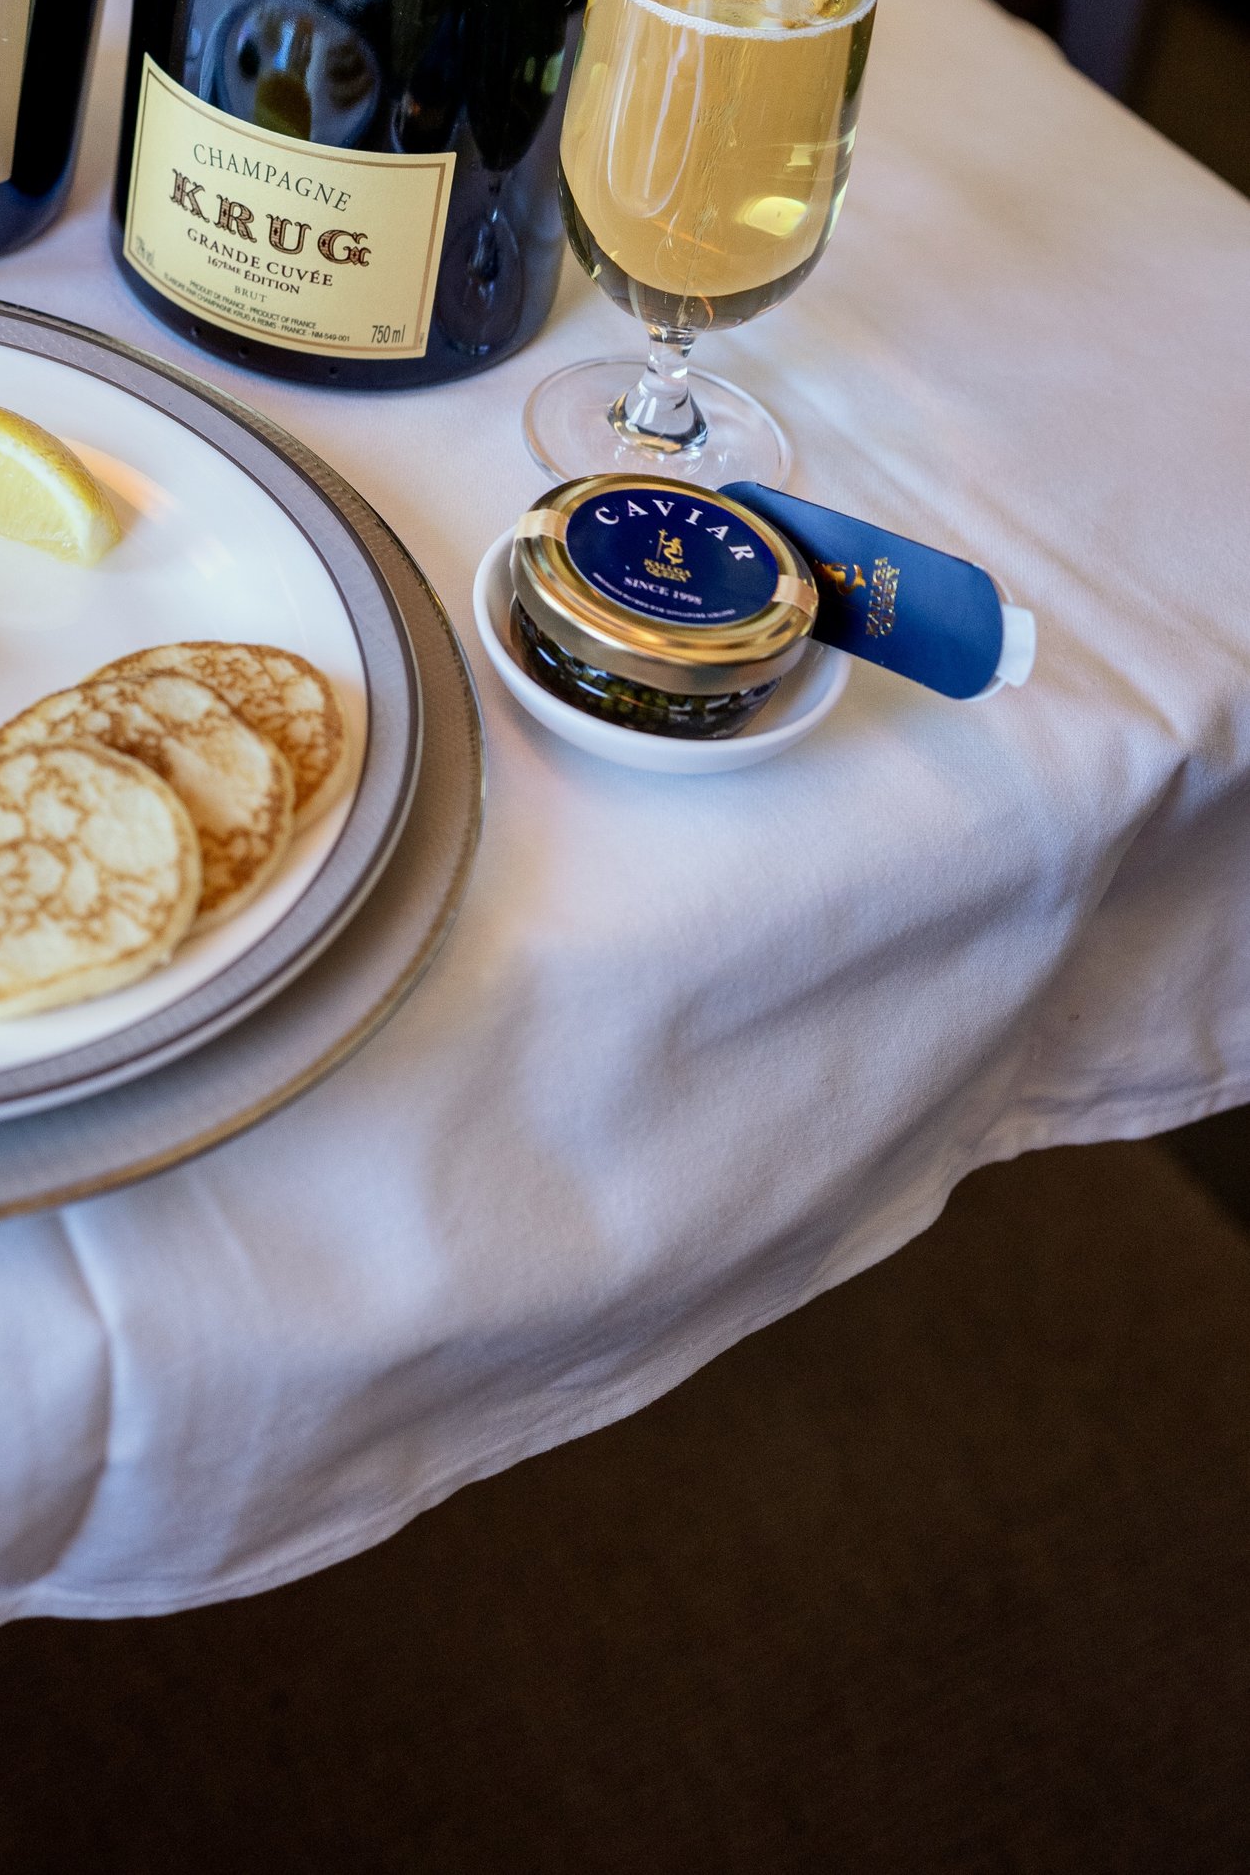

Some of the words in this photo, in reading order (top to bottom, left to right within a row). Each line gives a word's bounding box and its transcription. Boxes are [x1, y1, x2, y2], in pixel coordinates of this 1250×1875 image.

[193, 142, 352, 212] CHAMPAGNE
[168, 168, 372, 267] KRUG
[187, 228, 261, 269] GRANDE
[266, 261, 334, 287] CUVÉE
[234, 285, 268, 303] BRUT
[244, 269, 300, 294] ÉDITION
[222, 294, 246, 311] FRANCE
[250, 304, 280, 321] PRODUCT
[281, 314, 291, 324] OF
[291, 316, 317, 329] FRANCE
[281, 324, 310, 336] FRANCE
[371, 324, 391, 344] 750
[391, 324, 407, 343] ml
[595, 499, 756, 561] CAVIAR
[623, 576, 670, 597] SINCE
